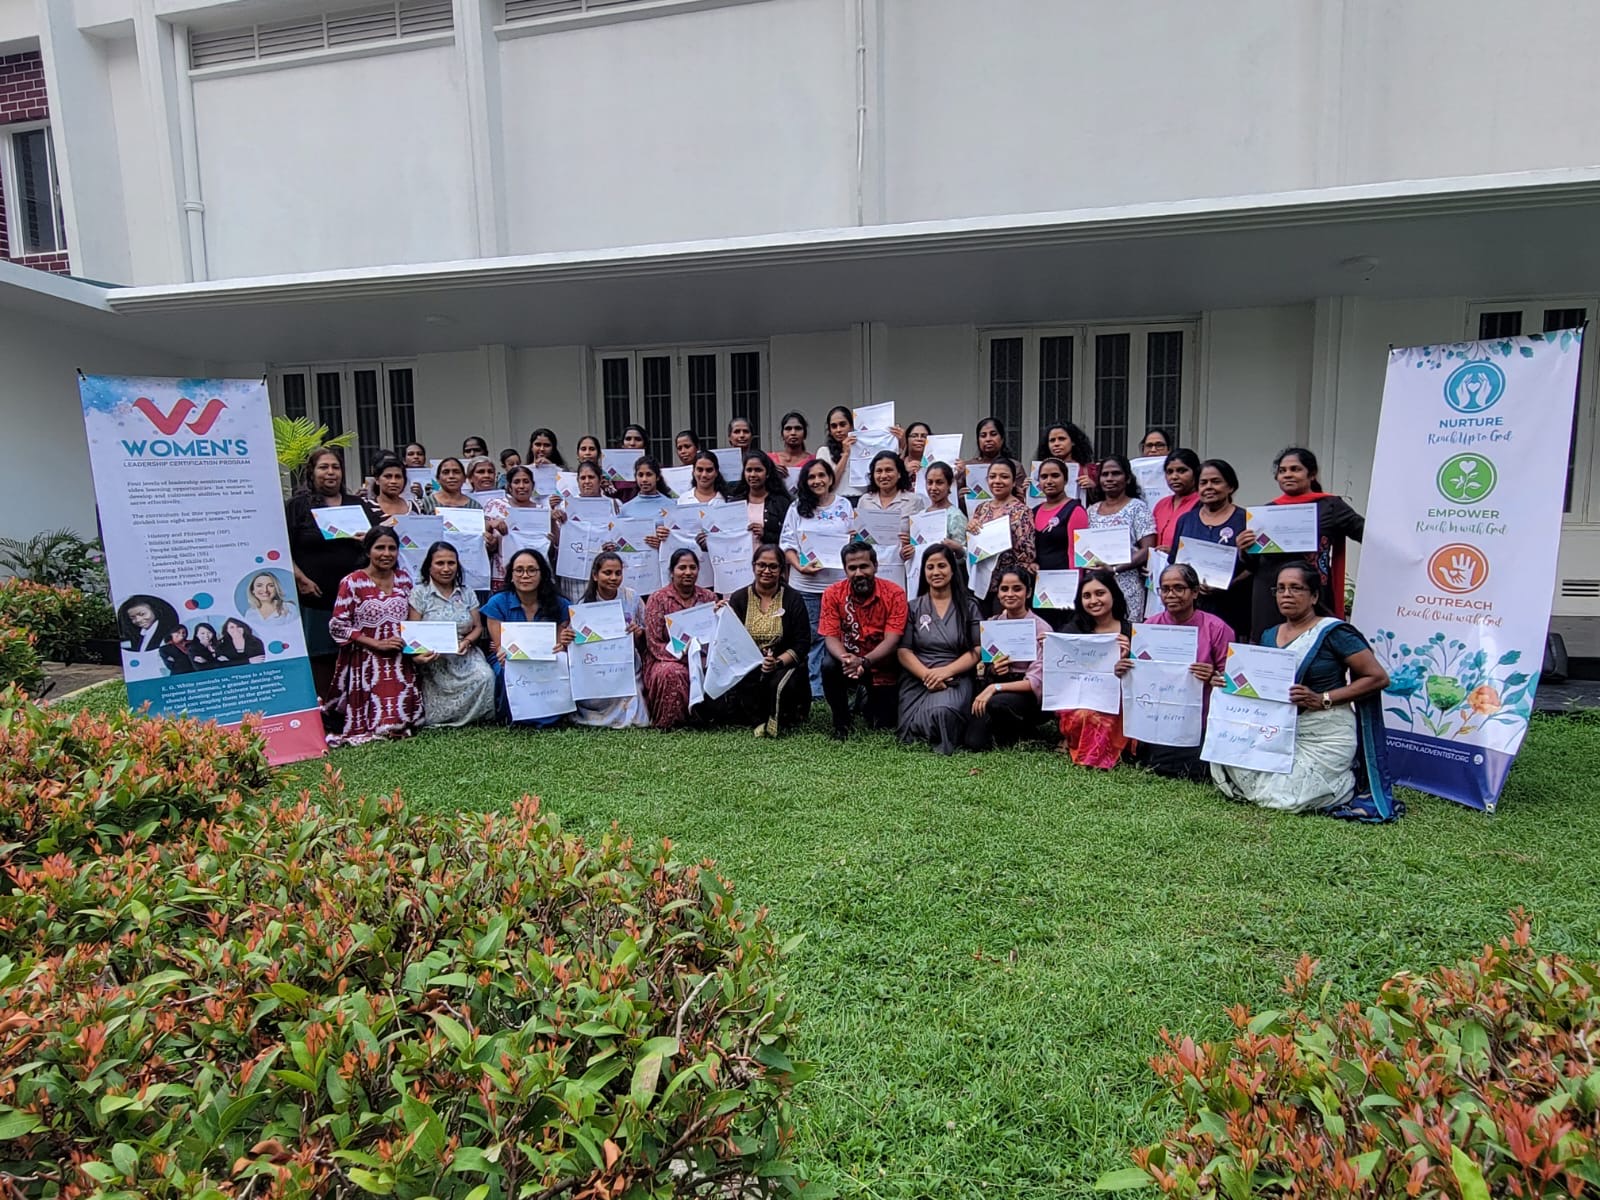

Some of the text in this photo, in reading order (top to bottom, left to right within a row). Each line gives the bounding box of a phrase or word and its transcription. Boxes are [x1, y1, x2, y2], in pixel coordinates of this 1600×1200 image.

[1439, 416, 1504, 428] NURTURE
[1428, 429, 1513, 446] Reach Up to God
[121, 438, 249, 457] WOMEN'S
[1427, 508, 1500, 519] EMPOWER
[1416, 520, 1447, 533] Reach
[1460, 521, 1484, 535] with
[1485, 522, 1507, 535] God
[151, 559, 184, 567] Leadership
[1415, 595, 1493, 611] OUTREACH
[1396, 606, 1503, 627] Reach Out with God
[161, 691, 186, 699] purpose
[227, 680, 249, 689] grander
[195, 678, 220, 686] reminds
[166, 696, 186, 704] should
[187, 693, 210, 701] develop
[199, 698, 221, 706] employ
[256, 689, 271, 697] great
[1385, 739, 1470, 763] WOMEN.ADVENTIST.ORG
